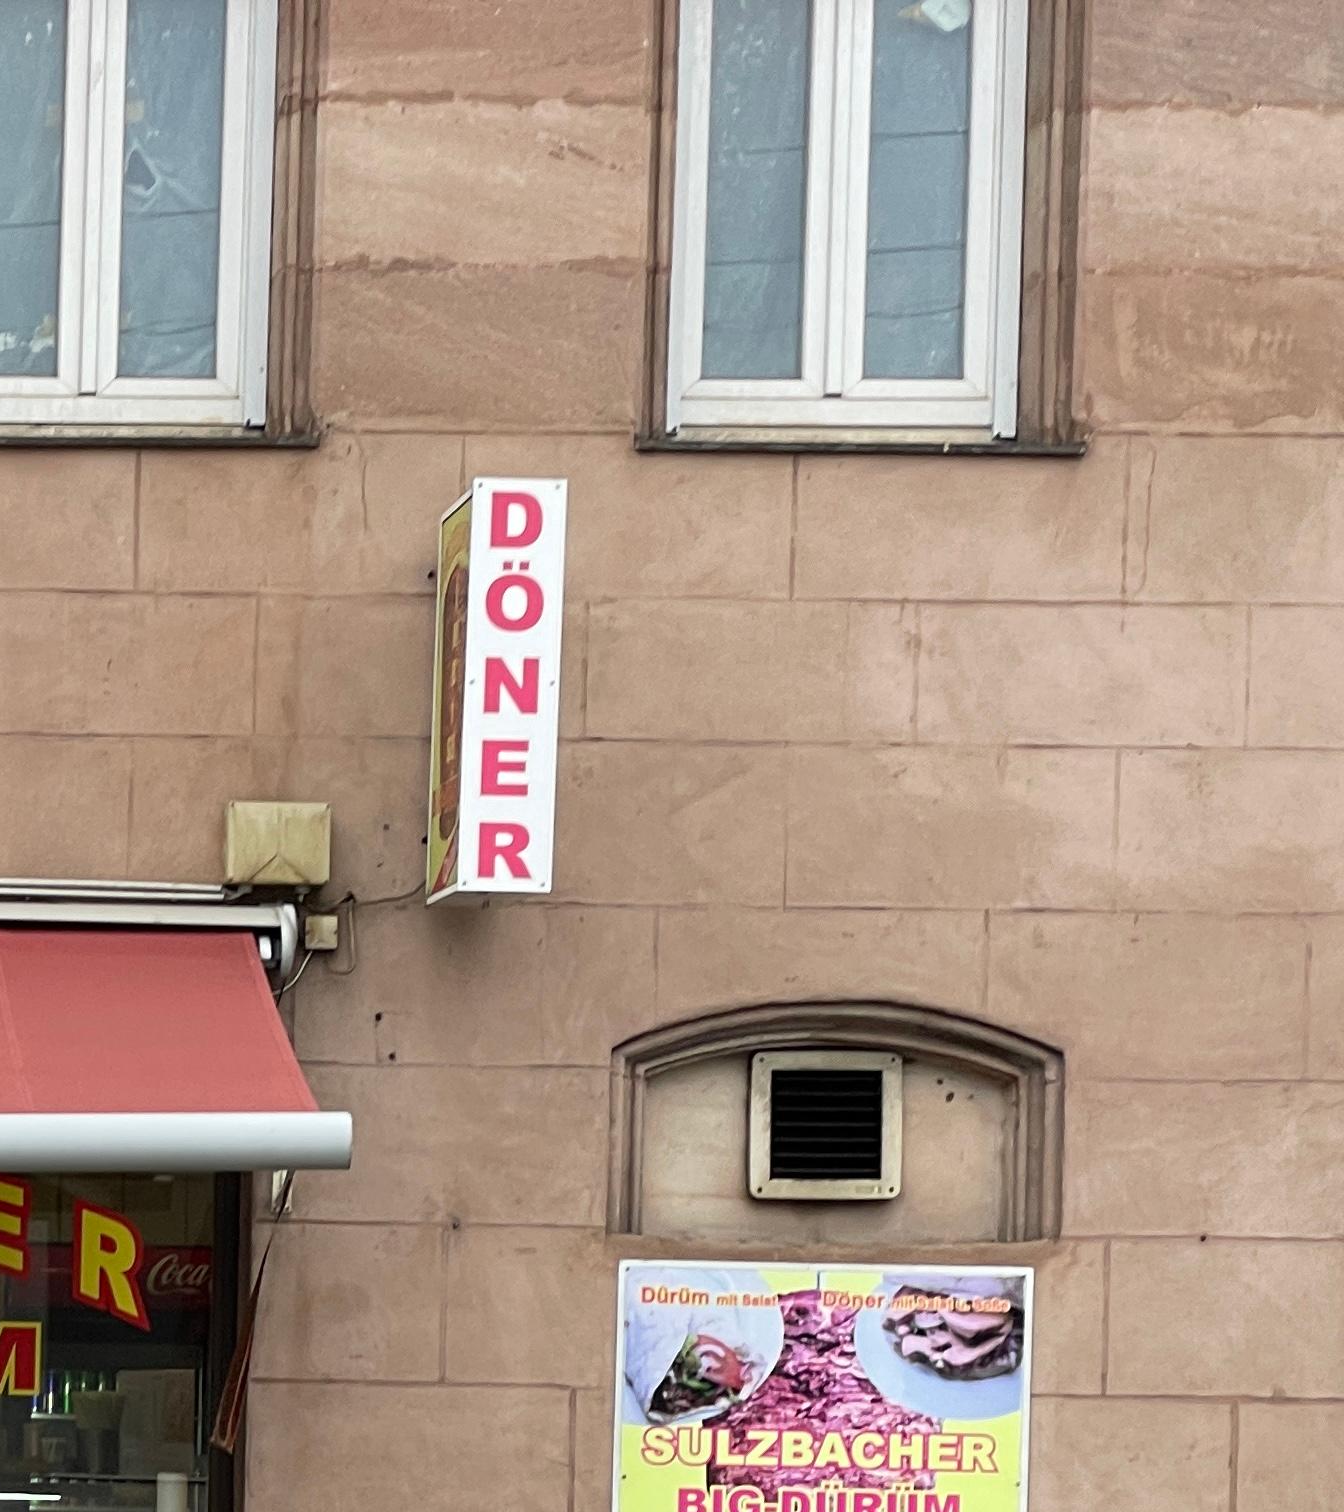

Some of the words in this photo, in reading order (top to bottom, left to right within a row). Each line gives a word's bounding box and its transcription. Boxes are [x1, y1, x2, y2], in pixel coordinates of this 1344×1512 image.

[477, 491, 545, 879] DÖNER
[641, 1286, 710, 1306] Dürüm
[716, 1294, 738, 1306] mit
[822, 1291, 885, 1312] Döner
[641, 1425, 1000, 1473] SULZBACHER
